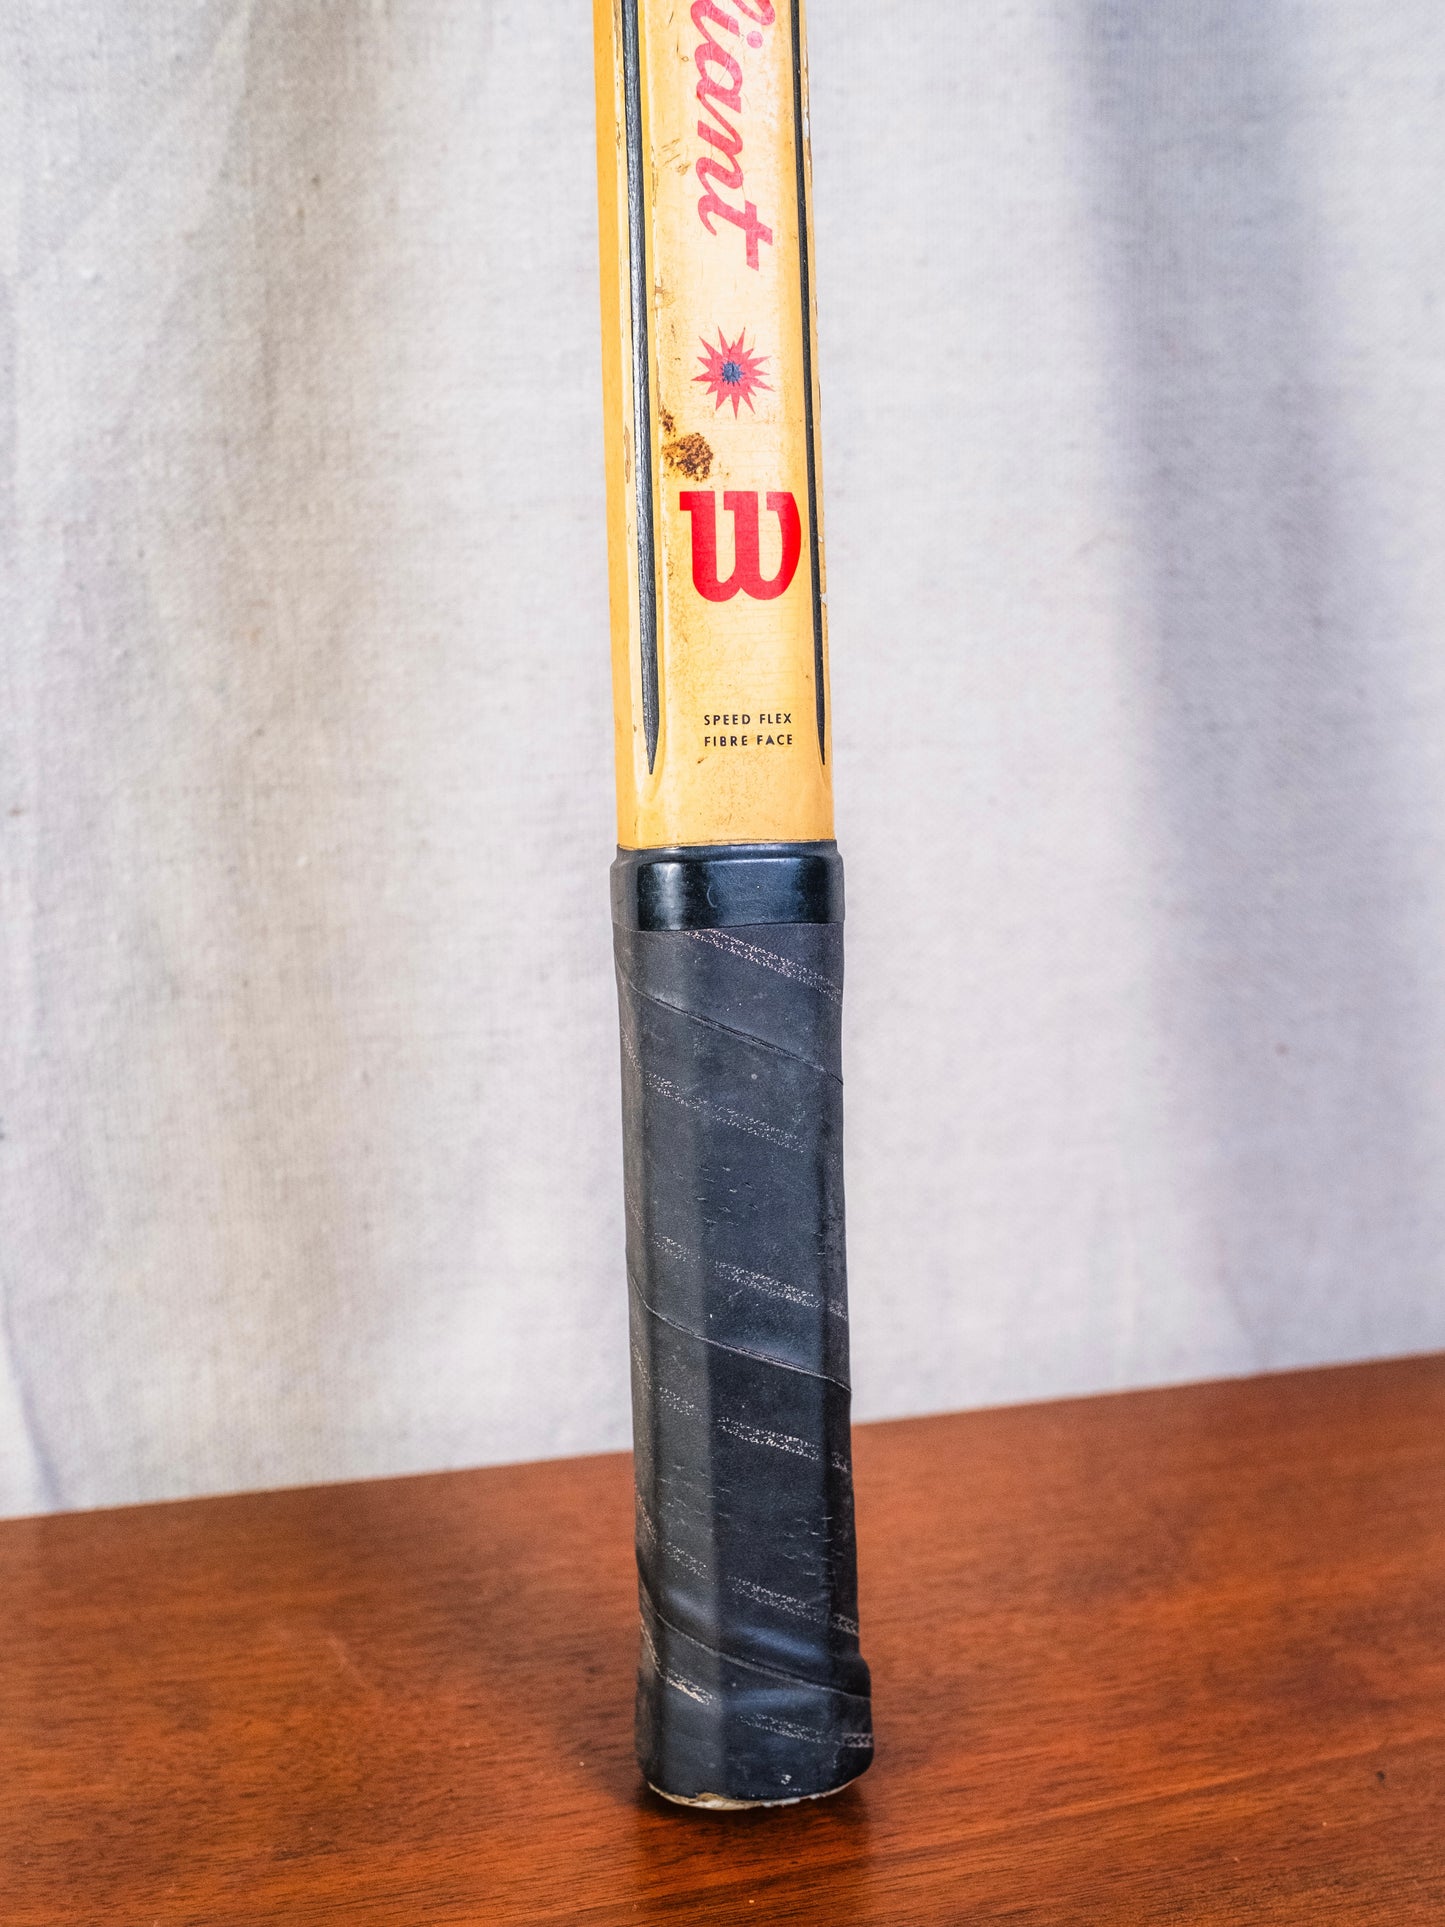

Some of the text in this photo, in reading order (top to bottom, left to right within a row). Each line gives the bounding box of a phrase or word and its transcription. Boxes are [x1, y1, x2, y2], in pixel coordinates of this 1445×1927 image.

[703, 713, 792, 726] SPEED FLEX
[704, 734, 793, 747] FIBRE FACE
